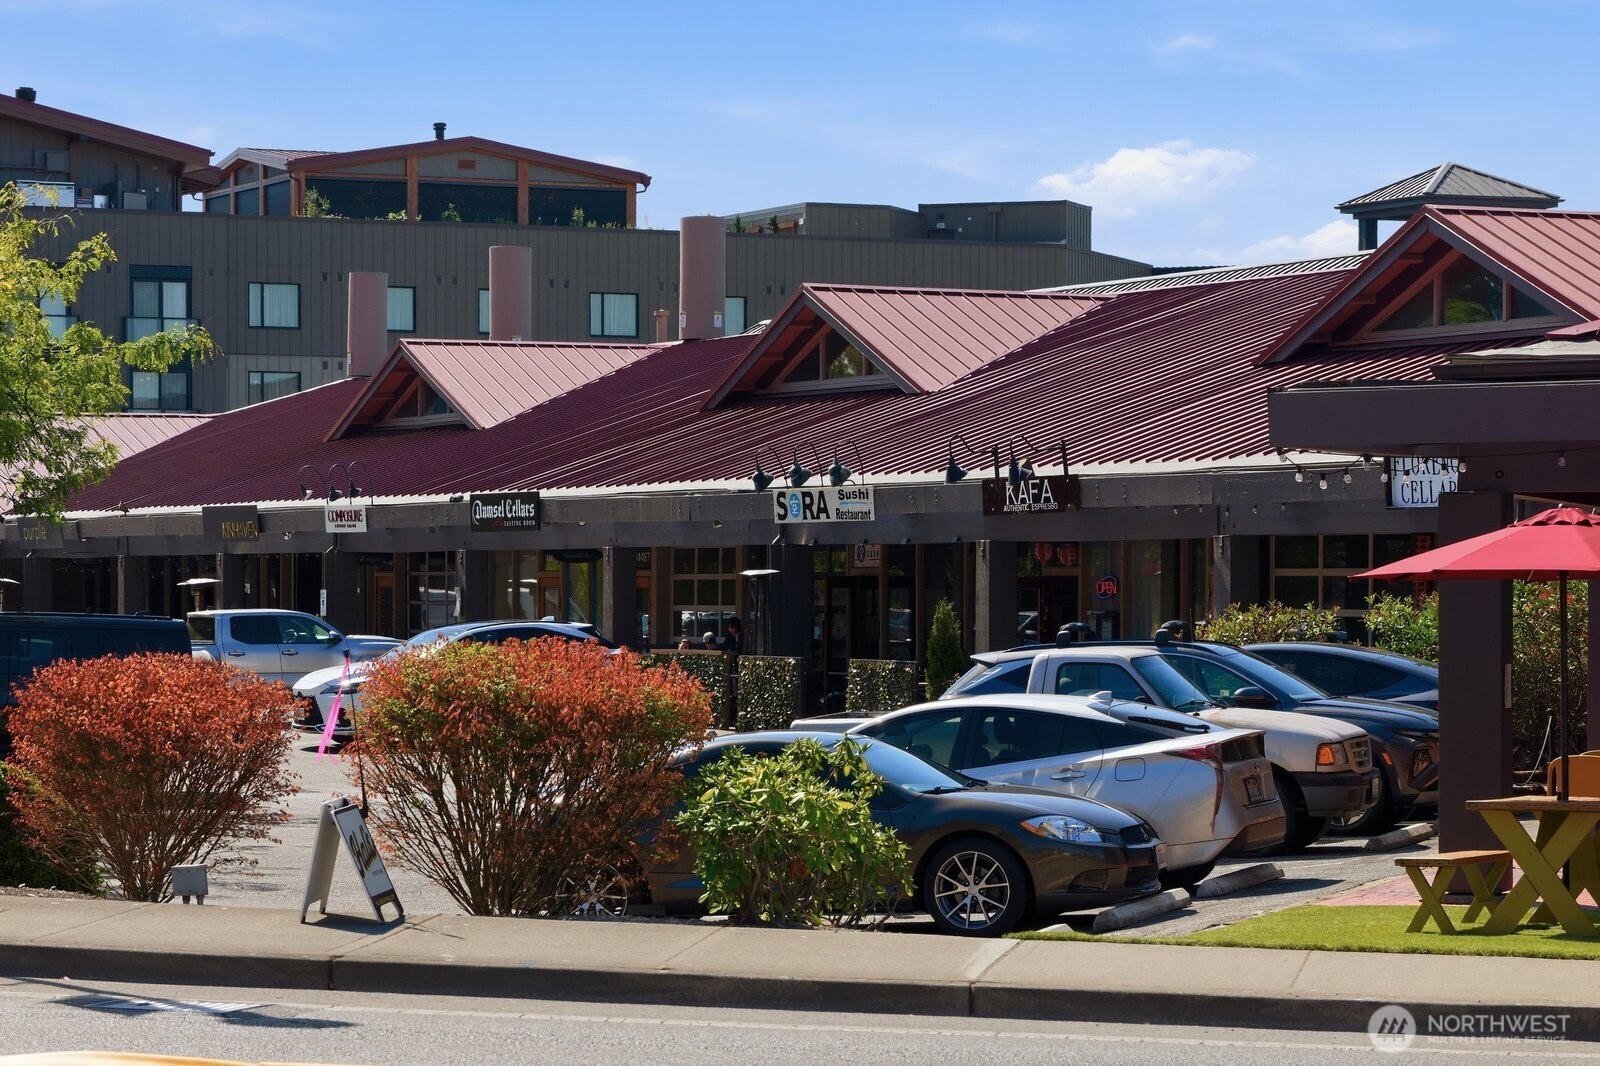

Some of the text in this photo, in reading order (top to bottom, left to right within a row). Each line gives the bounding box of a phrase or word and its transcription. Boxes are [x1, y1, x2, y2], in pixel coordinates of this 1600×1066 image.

[838, 488, 869, 501] Sushi
[1006, 479, 1054, 505] KAFA
[472, 499, 535, 525] Damsel Cellars
[1003, 502, 1058, 512] AUTHENTIC ESPRESSO
[835, 508, 871, 521] Restaurant
[23, 527, 47, 544] purple
[1096, 581, 1117, 594] OPEN
